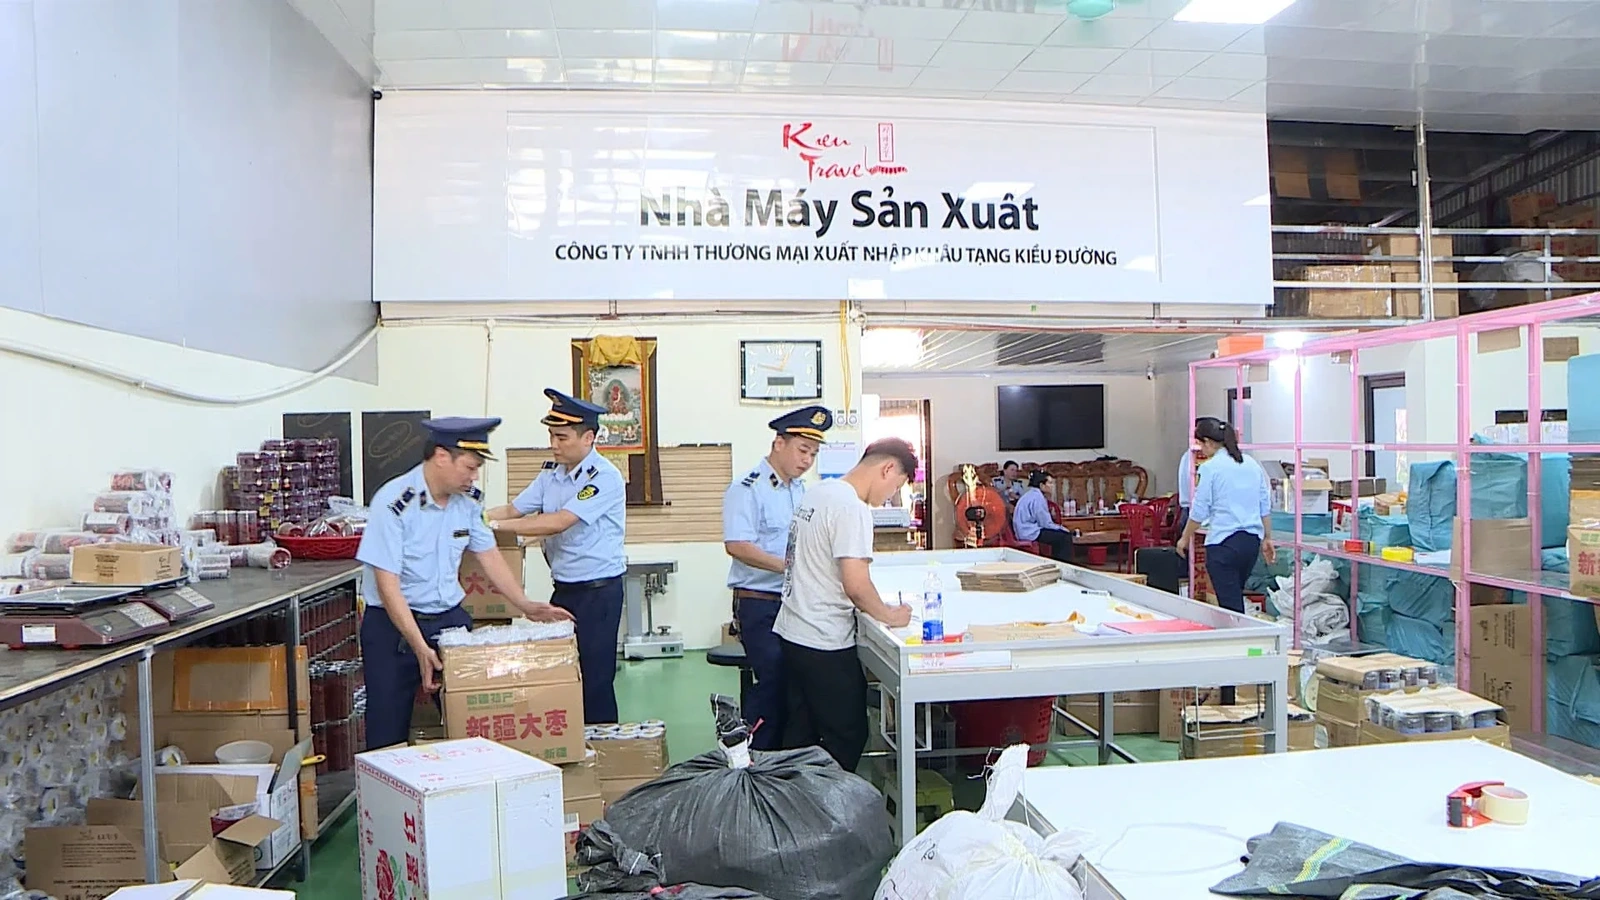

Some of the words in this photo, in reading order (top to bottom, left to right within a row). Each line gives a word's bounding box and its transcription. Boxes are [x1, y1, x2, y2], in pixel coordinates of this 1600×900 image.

[640, 187, 730, 227] Nhà
[745, 188, 839, 238] Máy
[852, 186, 929, 228] Sản
[555, 241, 608, 261] CÔNG
[612, 245, 635, 260] TY
[639, 245, 690, 261] TNHH
[694, 243, 772, 261] THƯƠNG
[776, 245, 809, 264] MẠI
[813, 240, 859, 261] XUẤT
[965, 246, 1012, 266] TẠNG
[1055, 246, 1117, 266] ĐƯỜNG
[466, 709, 568, 741] 新疆大枣
